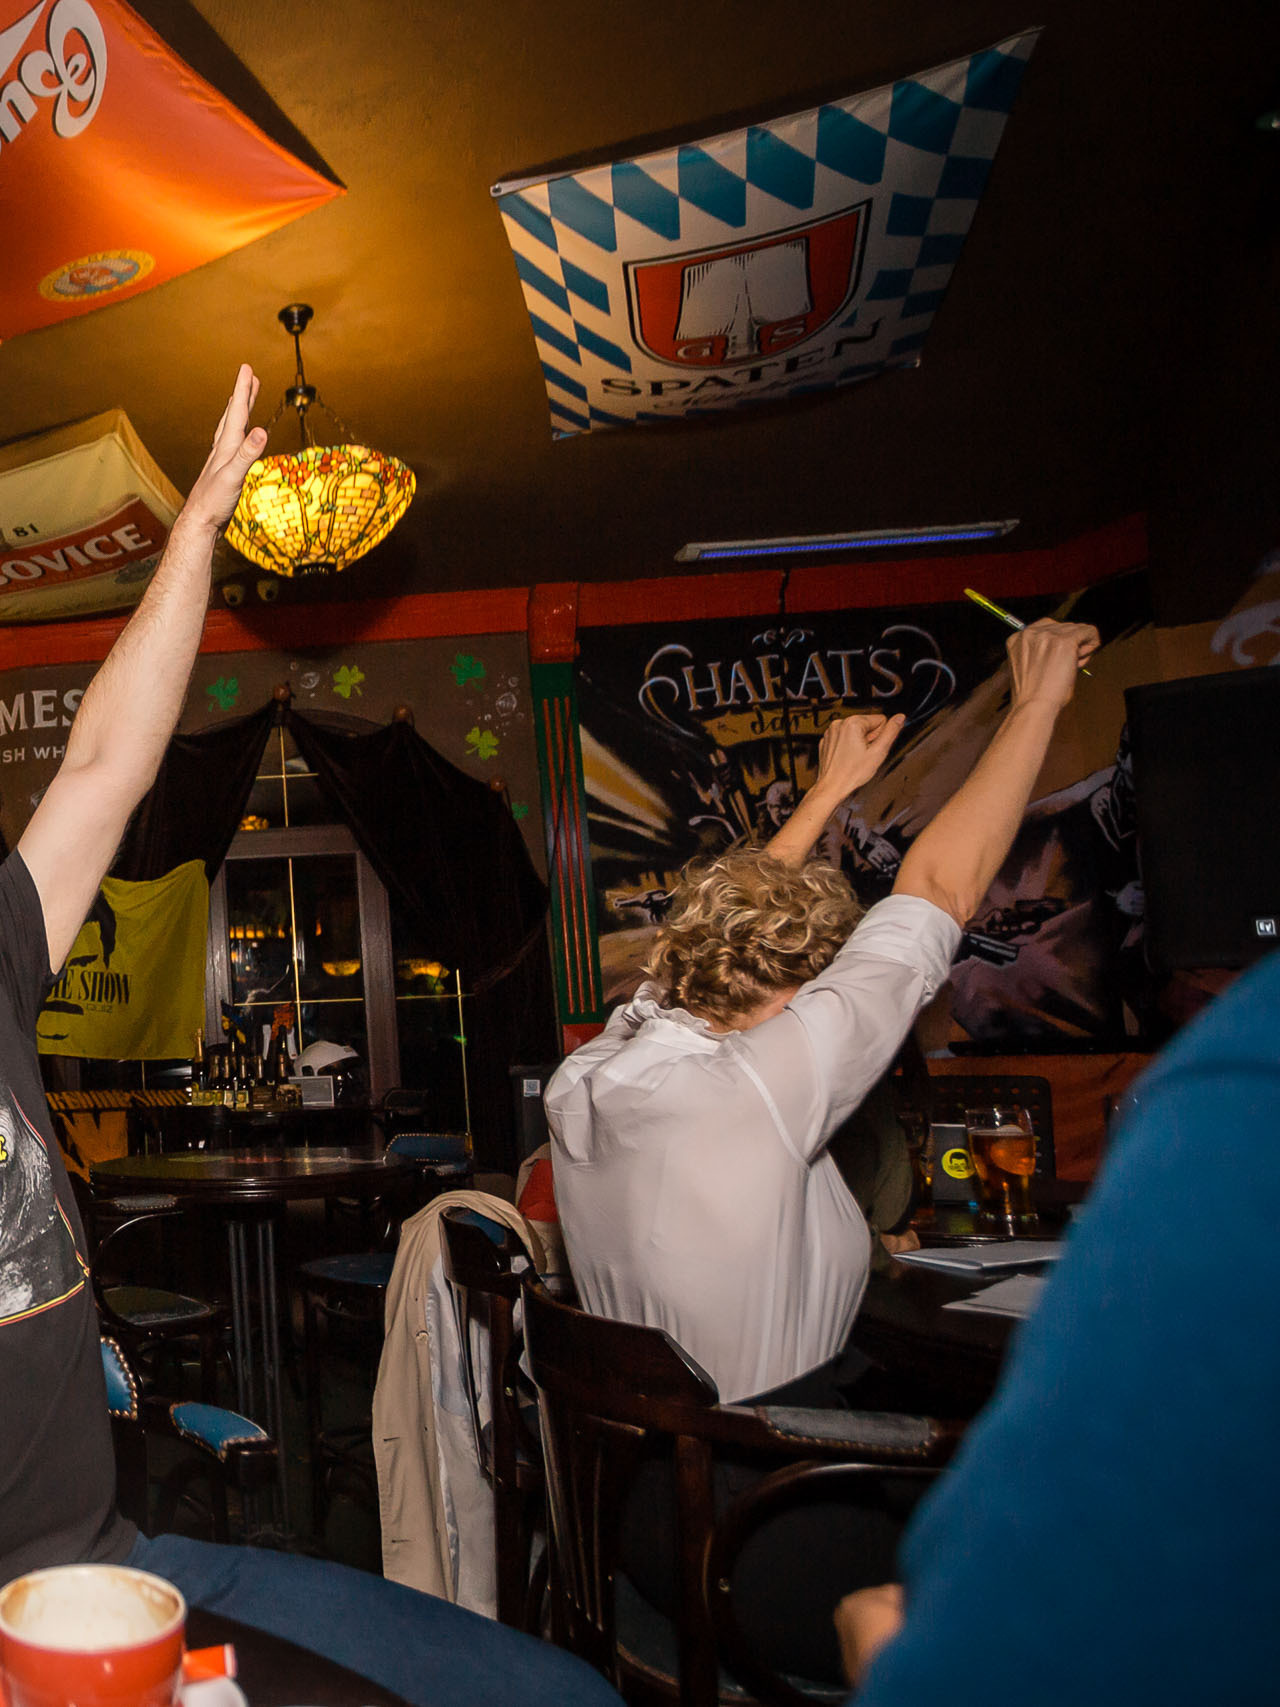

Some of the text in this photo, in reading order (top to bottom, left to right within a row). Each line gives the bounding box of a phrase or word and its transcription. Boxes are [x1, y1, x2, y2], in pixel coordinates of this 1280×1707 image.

[601, 318, 881, 396] SPATEN
[12, 523, 40, 538] 81
[33, 746, 65, 759] WH
[80, 970, 132, 1004] SHOW
